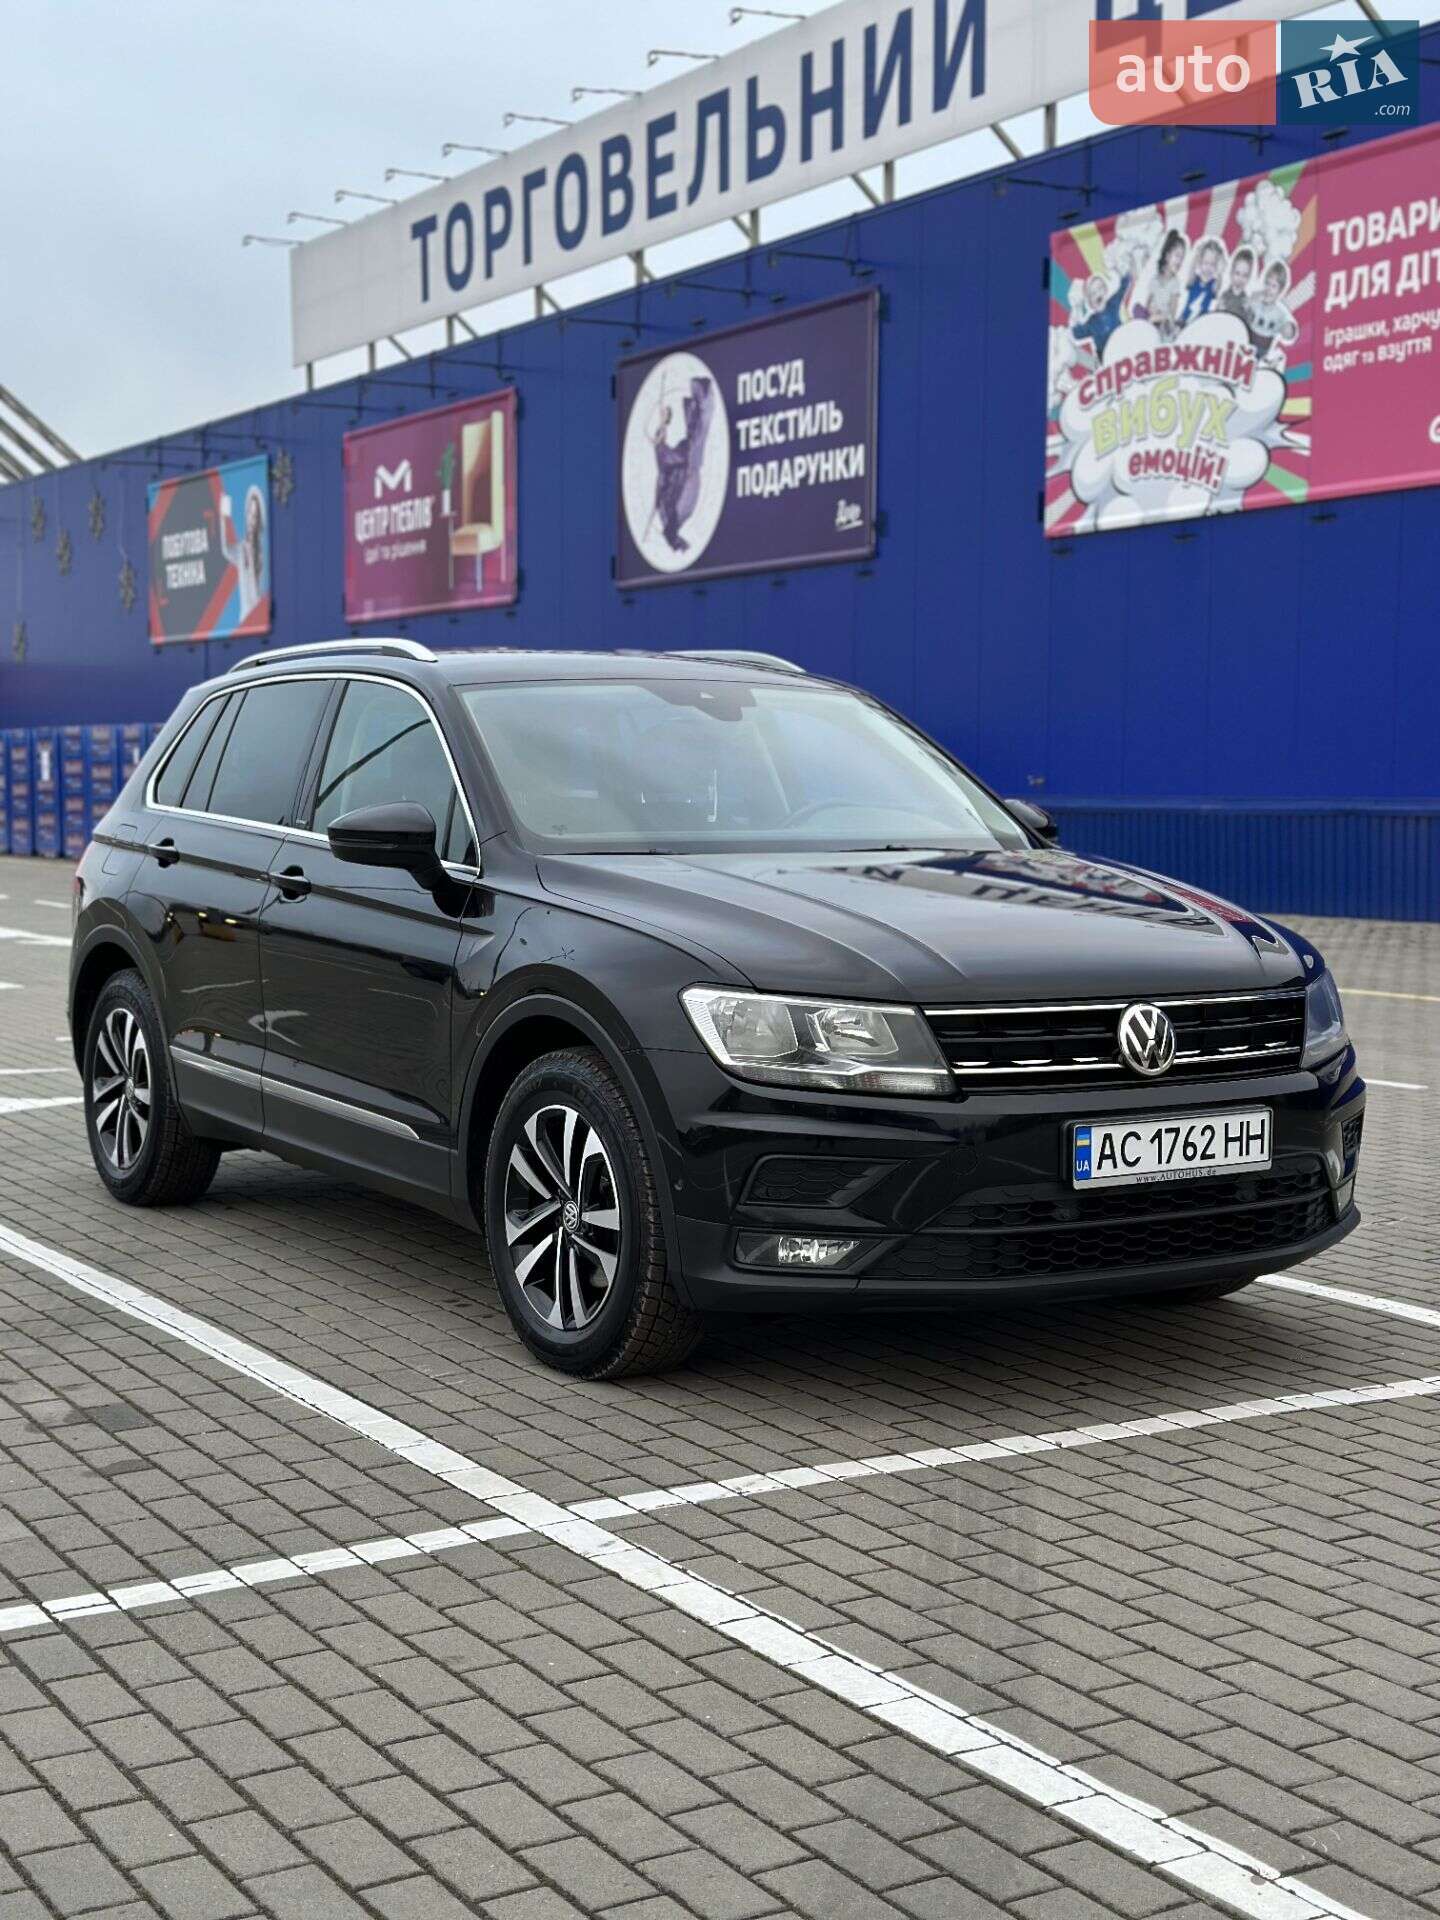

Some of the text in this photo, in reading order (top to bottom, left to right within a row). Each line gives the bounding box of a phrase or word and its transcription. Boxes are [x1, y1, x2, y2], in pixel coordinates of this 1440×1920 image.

[1324, 259, 1391, 313] ДЛЯ
[737, 359, 805, 404] ПОСУД
[1078, 340, 1255, 406] справжній
[736, 400, 844, 451] ТЕКСТИЛЬ
[1092, 376, 1236, 457] вибух
[736, 444, 866, 499] ПОДАРУНКИ
[1129, 446, 1227, 489] емоцій!
[1076, 1159, 1090, 1172] UA
[1097, 1118, 1266, 1170] AC 1762 HH
